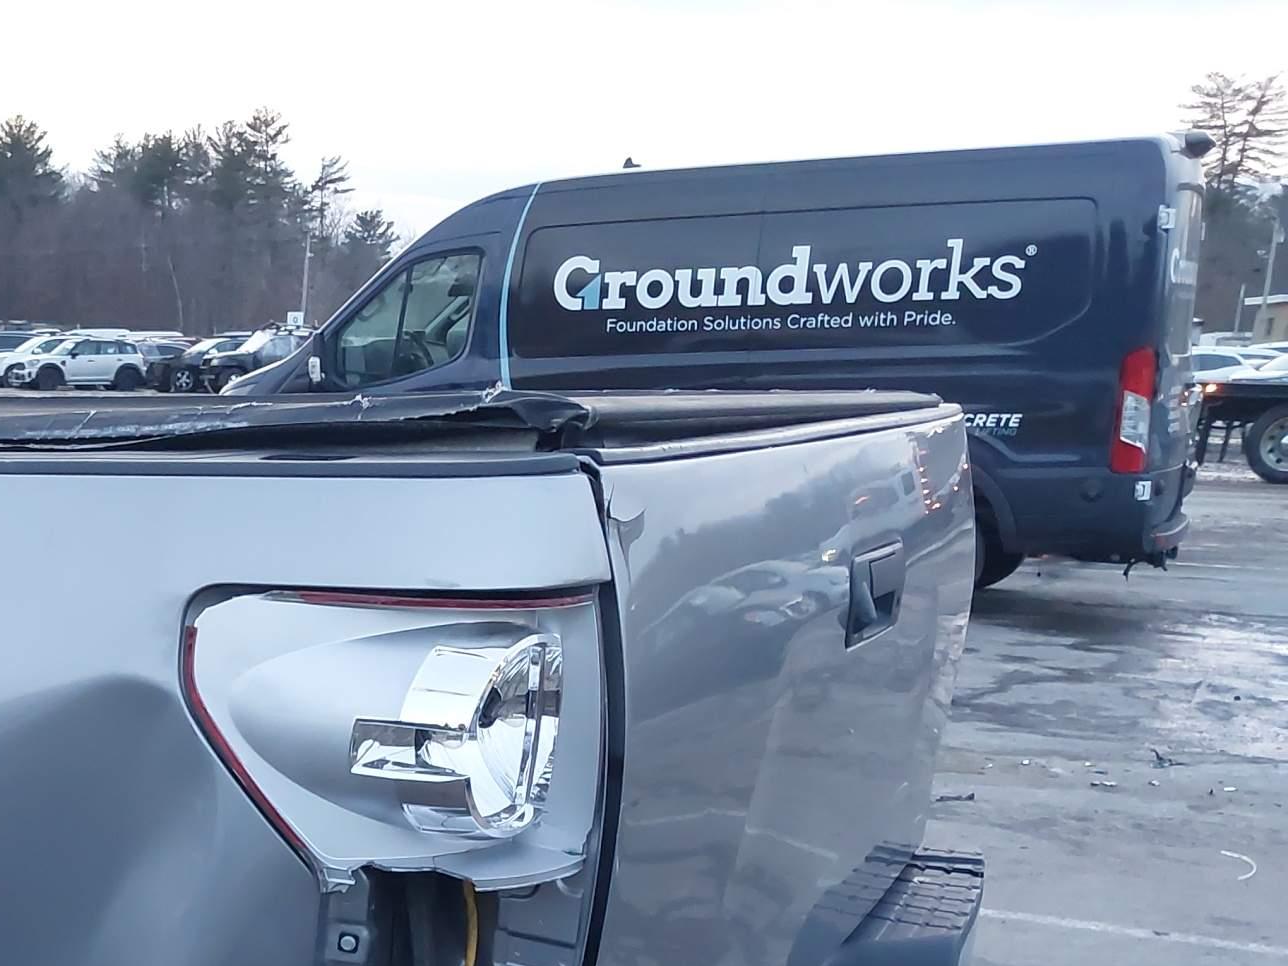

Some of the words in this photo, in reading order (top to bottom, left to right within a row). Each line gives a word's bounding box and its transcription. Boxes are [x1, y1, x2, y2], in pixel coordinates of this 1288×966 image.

[606, 317, 698, 332] Foundation
[703, 315, 781, 331] Solutions
[787, 312, 853, 329] Crafted
[859, 311, 897, 327] with
[903, 310, 956, 326] Pride.
